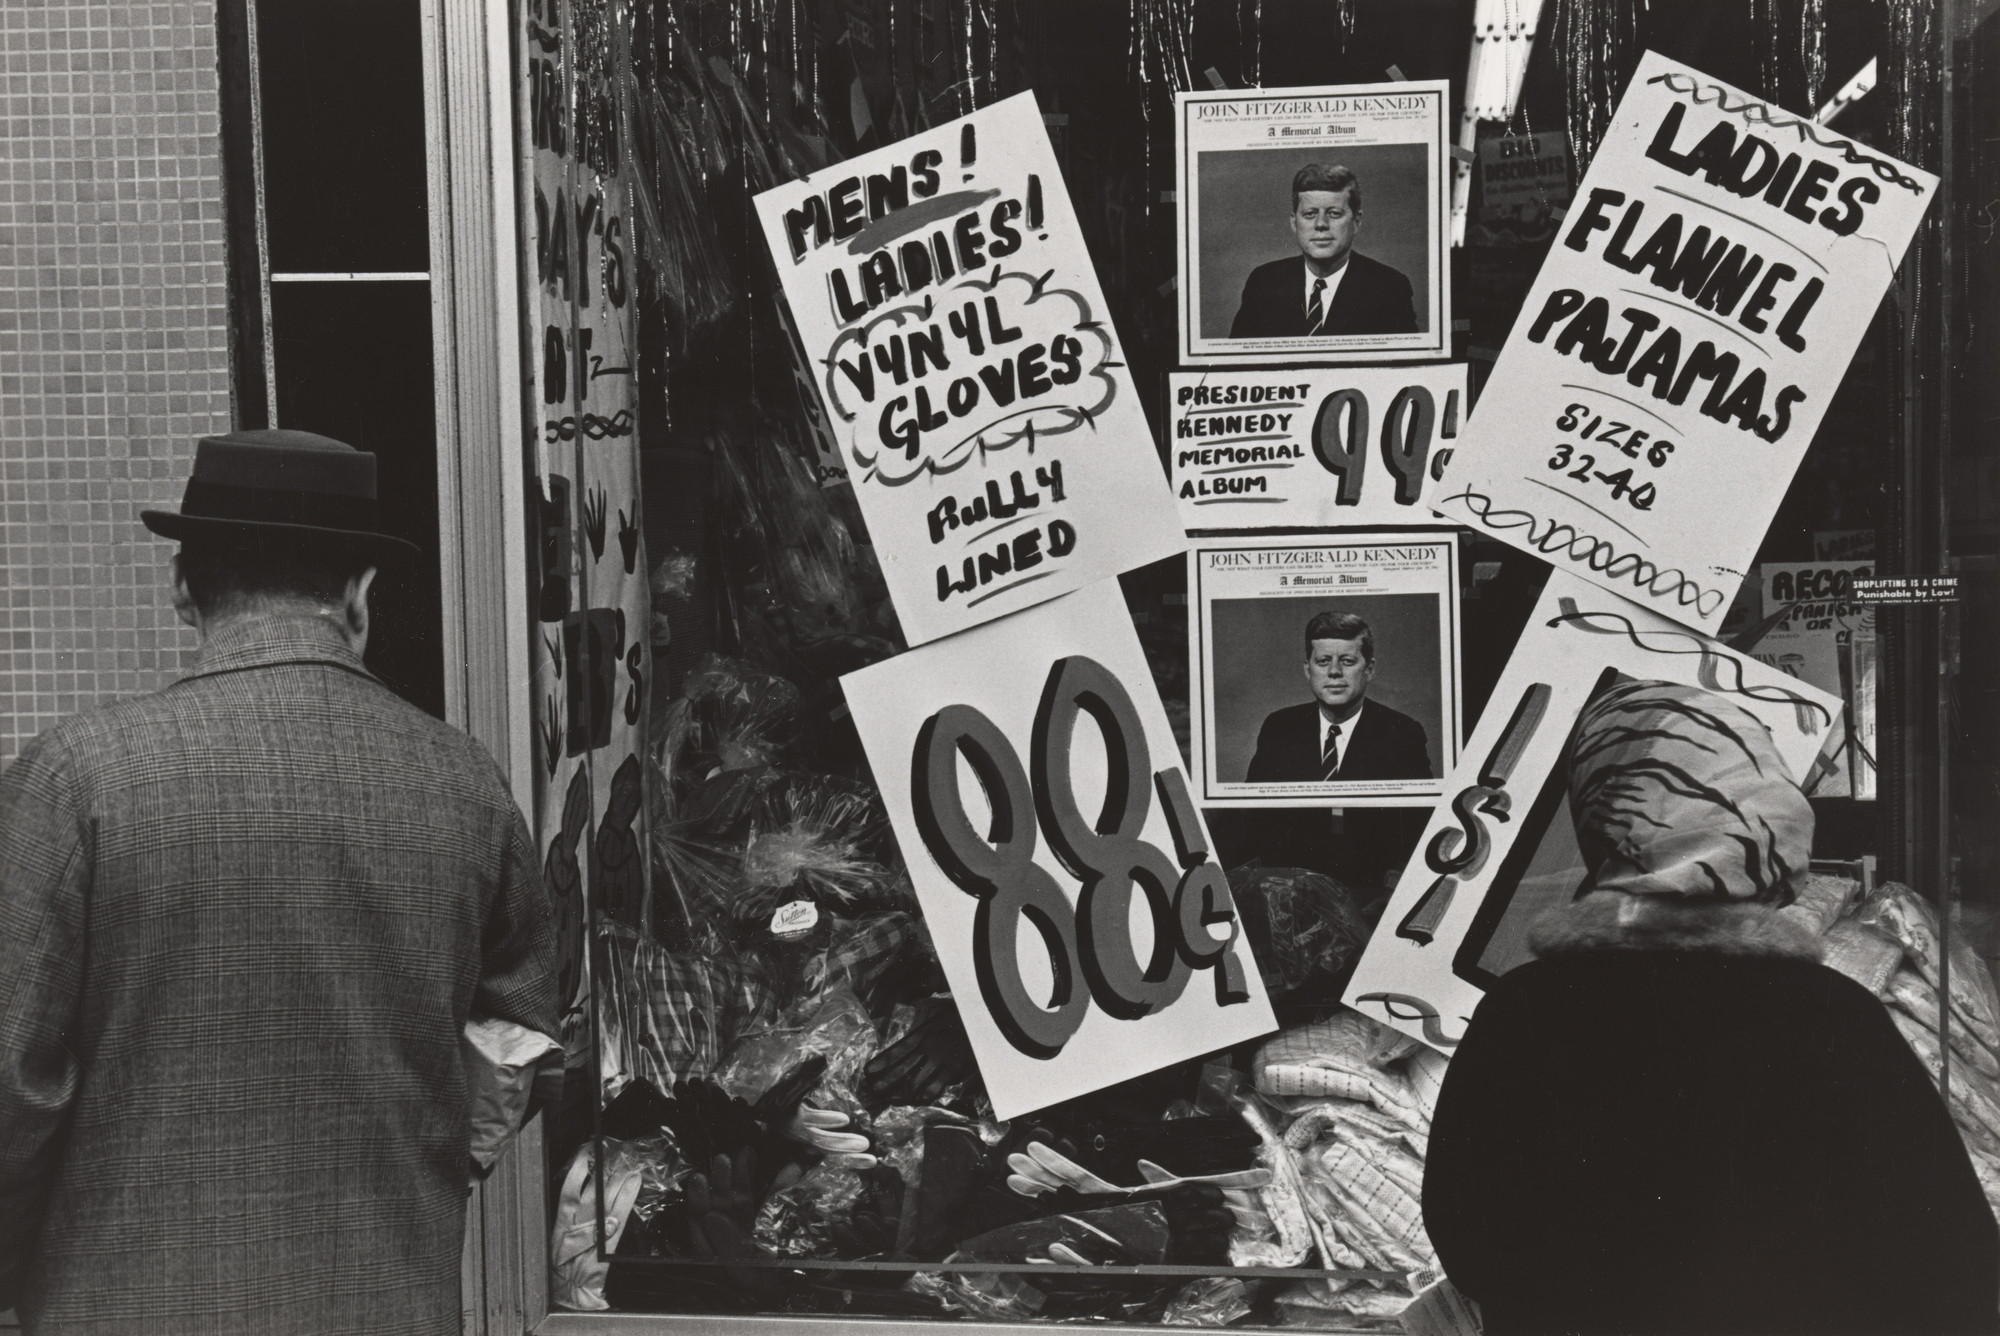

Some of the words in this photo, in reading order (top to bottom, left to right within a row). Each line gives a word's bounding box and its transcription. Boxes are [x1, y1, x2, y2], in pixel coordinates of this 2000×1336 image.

[1197, 104, 1239, 120] JOHN
[1246, 99, 1347, 116] FITZGERALD
[1353, 96, 1429, 111] KENNEDY
[1268, 127, 1276, 137] A
[1281, 125, 1322, 136] Memorial
[1327, 124, 1357, 135] Album
[1645, 101, 1881, 237] LADIES
[826, 174, 1050, 329] LADIES!
[1564, 187, 1824, 354] FLANNEL
[839, 297, 1023, 402] VYNYL
[1527, 288, 1807, 443] PAJAMAS
[879, 334, 1083, 460] GLOVES
[1177, 384, 1311, 405] PRESIDENT
[1177, 413, 1293, 439] KENNEDY
[1556, 402, 1675, 468] SIZES
[1179, 444, 1305, 467] MEMORIAL
[1179, 476, 1268, 499] ALBUM
[936, 519, 1077, 602] LINED
[1210, 553, 1251, 569] JOHN
[1258, 550, 1358, 565] FITZGERALD
[1364, 547, 1439, 562] KENNEDY
[1280, 576, 1288, 586] A
[1293, 574, 1333, 586] Memorial
[1338, 574, 1368, 584] Album
[1853, 579, 1907, 589] SHOPLIFTING
[1910, 579, 1919, 587] IS
[1922, 579, 1928, 587] A
[1932, 577, 1959, 586] CRIME
[1857, 589, 1912, 599] Punishable
[1915, 588, 1927, 598] by
[1931, 587, 1955, 597] Law!
